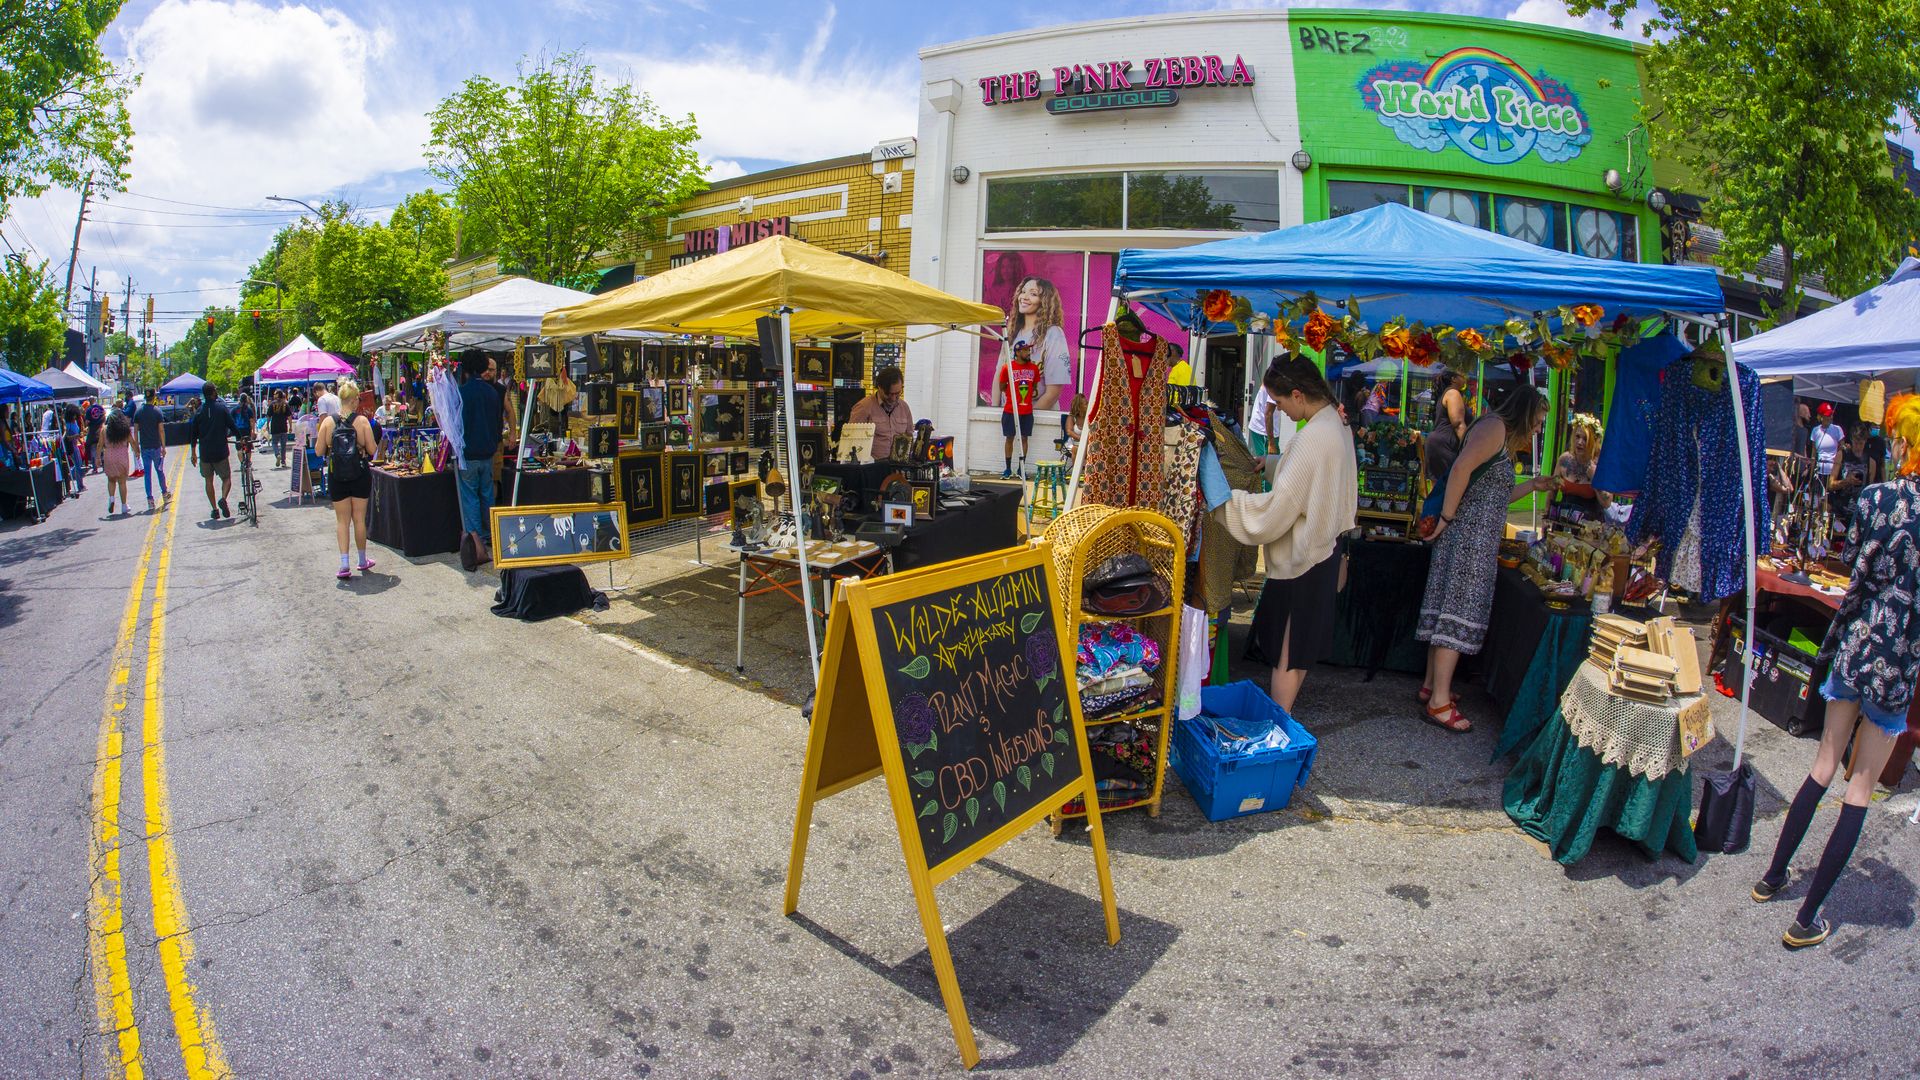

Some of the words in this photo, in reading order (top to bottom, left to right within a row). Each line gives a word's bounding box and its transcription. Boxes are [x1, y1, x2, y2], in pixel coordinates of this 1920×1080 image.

[979, 70, 1041, 106] THE
[1144, 54, 1255, 89] ZEBRA
[1054, 90, 1171, 111] BOUTIQUE
[1373, 79, 1491, 123] World
[1491, 86, 1583, 136] Piece
[684, 216, 791, 254] NIRMISH
[885, 593, 968, 655] WILDE
[970, 568, 1042, 620] AUTUMN
[928, 672, 979, 734] PLANT
[976, 654, 1029, 713] MAGIC
[939, 757, 989, 809] CBD
[989, 709, 1053, 779] INFUSIONS
